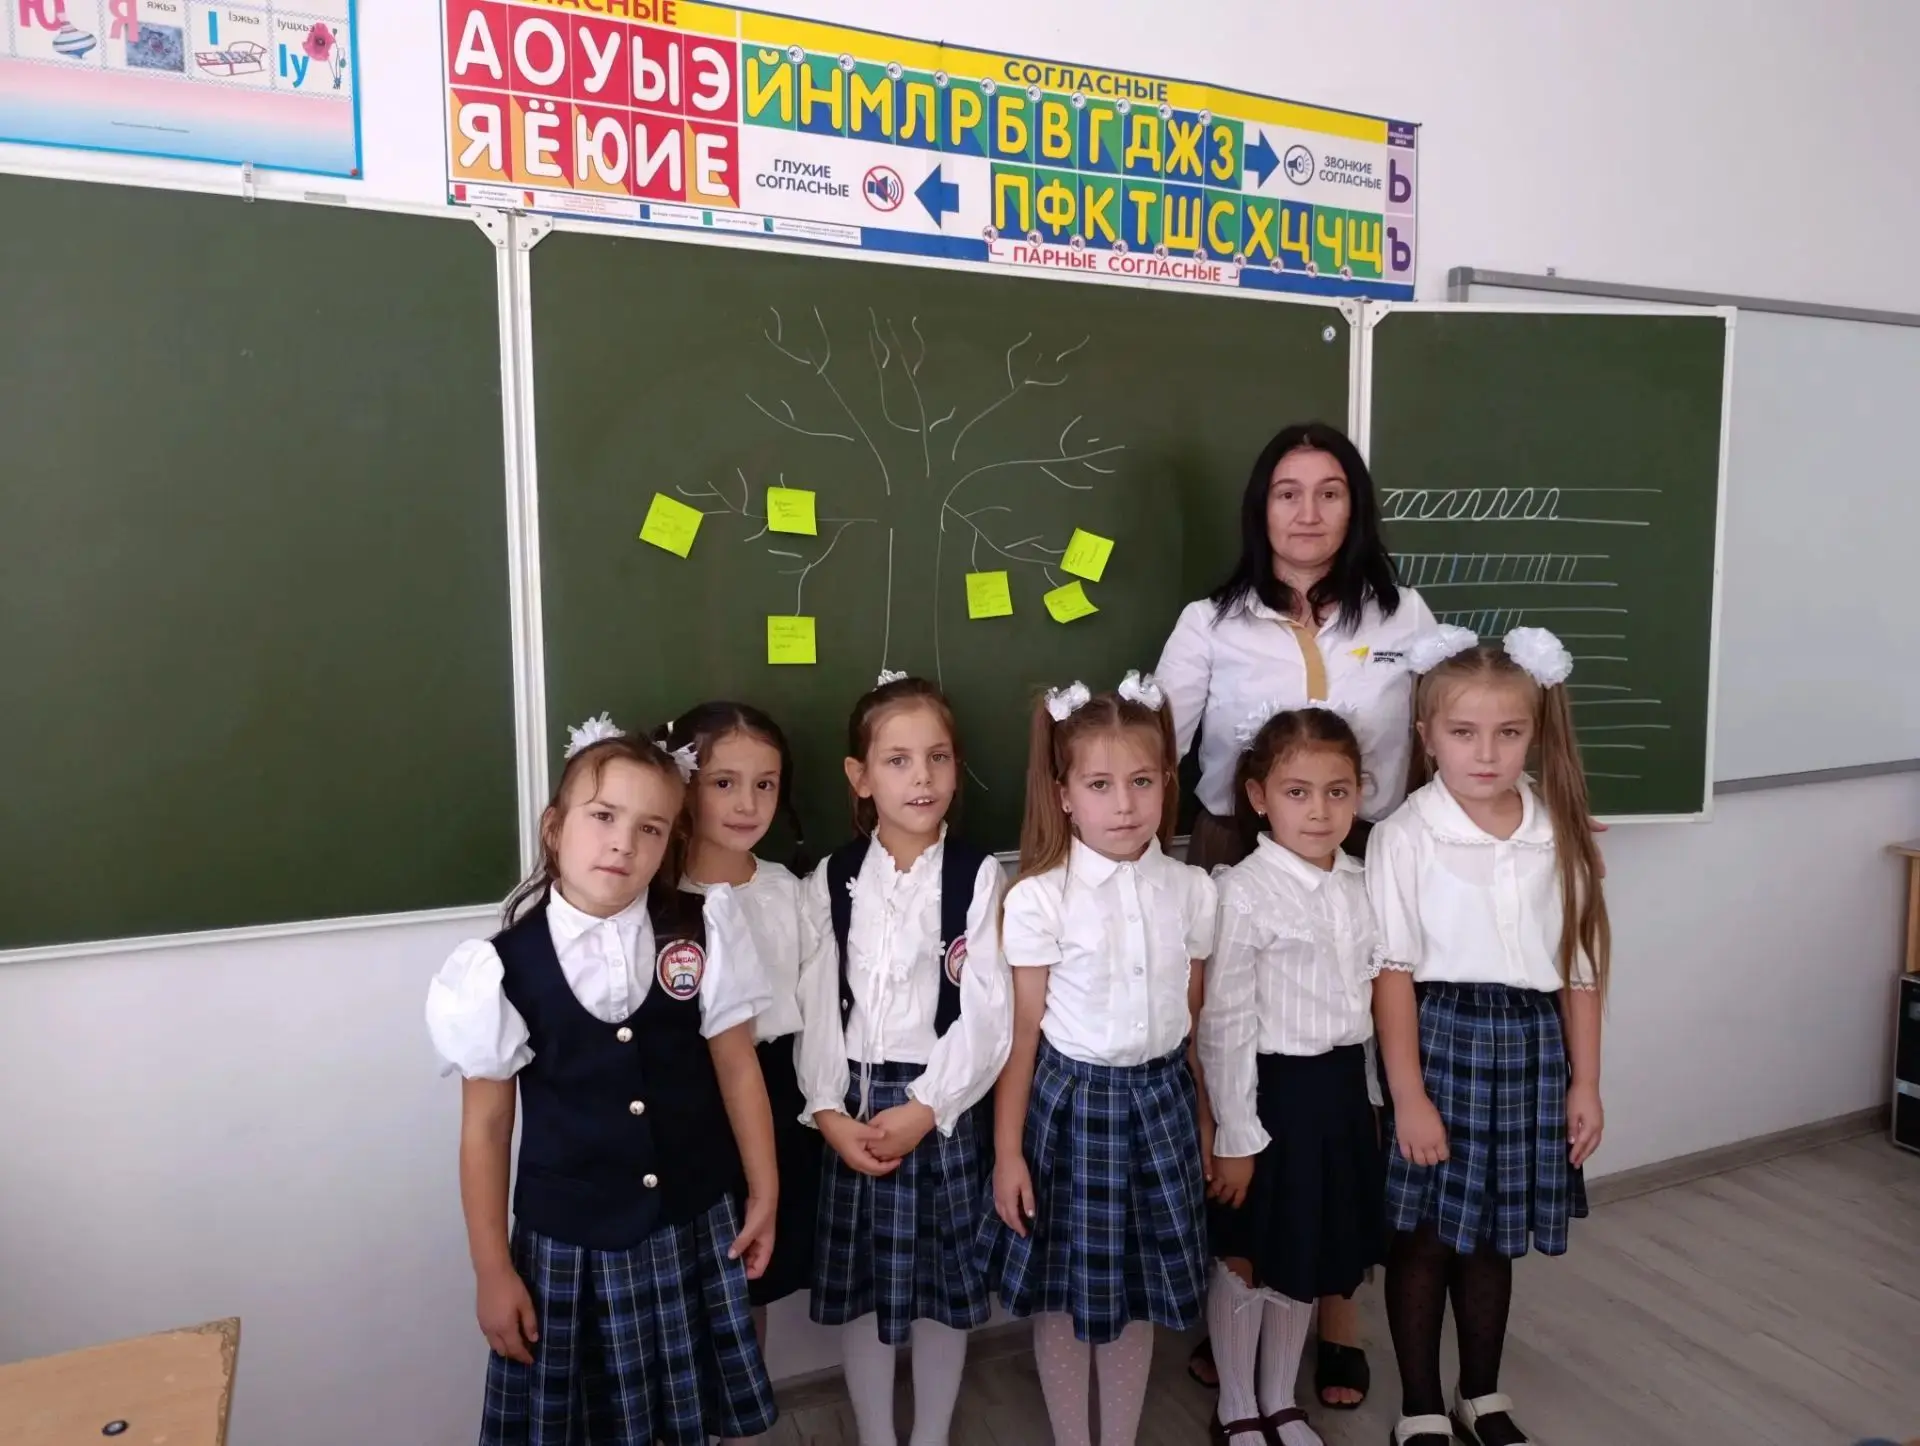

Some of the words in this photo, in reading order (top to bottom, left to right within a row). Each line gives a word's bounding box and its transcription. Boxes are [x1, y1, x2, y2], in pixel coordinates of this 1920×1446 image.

[454, 9, 503, 80] А
[514, 17, 566, 86] О
[579, 26, 621, 93] У
[632, 35, 680, 107] Ы
[692, 47, 730, 111] Э
[1004, 60, 1168, 103] СОГЛАСНЫЕ
[747, 49, 792, 122] Й
[801, 63, 842, 129] Н
[851, 73, 892, 136] М
[900, 82, 935, 143] Л
[951, 88, 982, 146] Р
[997, 96, 1027, 153] Б
[1042, 102, 1072, 159] В
[1090, 108, 1113, 164] Г
[1125, 115, 1161, 172] Д
[1166, 119, 1203, 177] Ж
[1211, 125, 1234, 180] З
[458, 102, 503, 171] Я
[524, 99, 562, 178] Ё
[576, 113, 629, 185] Ю
[635, 123, 682, 192] И
[695, 132, 730, 197] Е
[1323, 155, 1372, 175] ЗВОНКИЕ
[756, 173, 849, 197] СОГЛАСНЫЕ
[774, 158, 831, 178] ГЛУХИЕ
[1319, 169, 1382, 190] СОГЛАСНЫЕ
[995, 173, 1029, 232] П
[1036, 179, 1075, 236] Ф
[1084, 185, 1116, 243] К
[1129, 190, 1157, 245] Т
[1164, 194, 1201, 250] Ш
[1207, 200, 1235, 254] С
[1244, 205, 1273, 260] Х
[1281, 208, 1310, 264] Ц
[1317, 214, 1343, 267] Ч
[1348, 218, 1382, 273] Щ
[1013, 246, 1097, 269] ПАРНЫЕ
[1108, 256, 1221, 281] СОГЛАСНЫЕ
